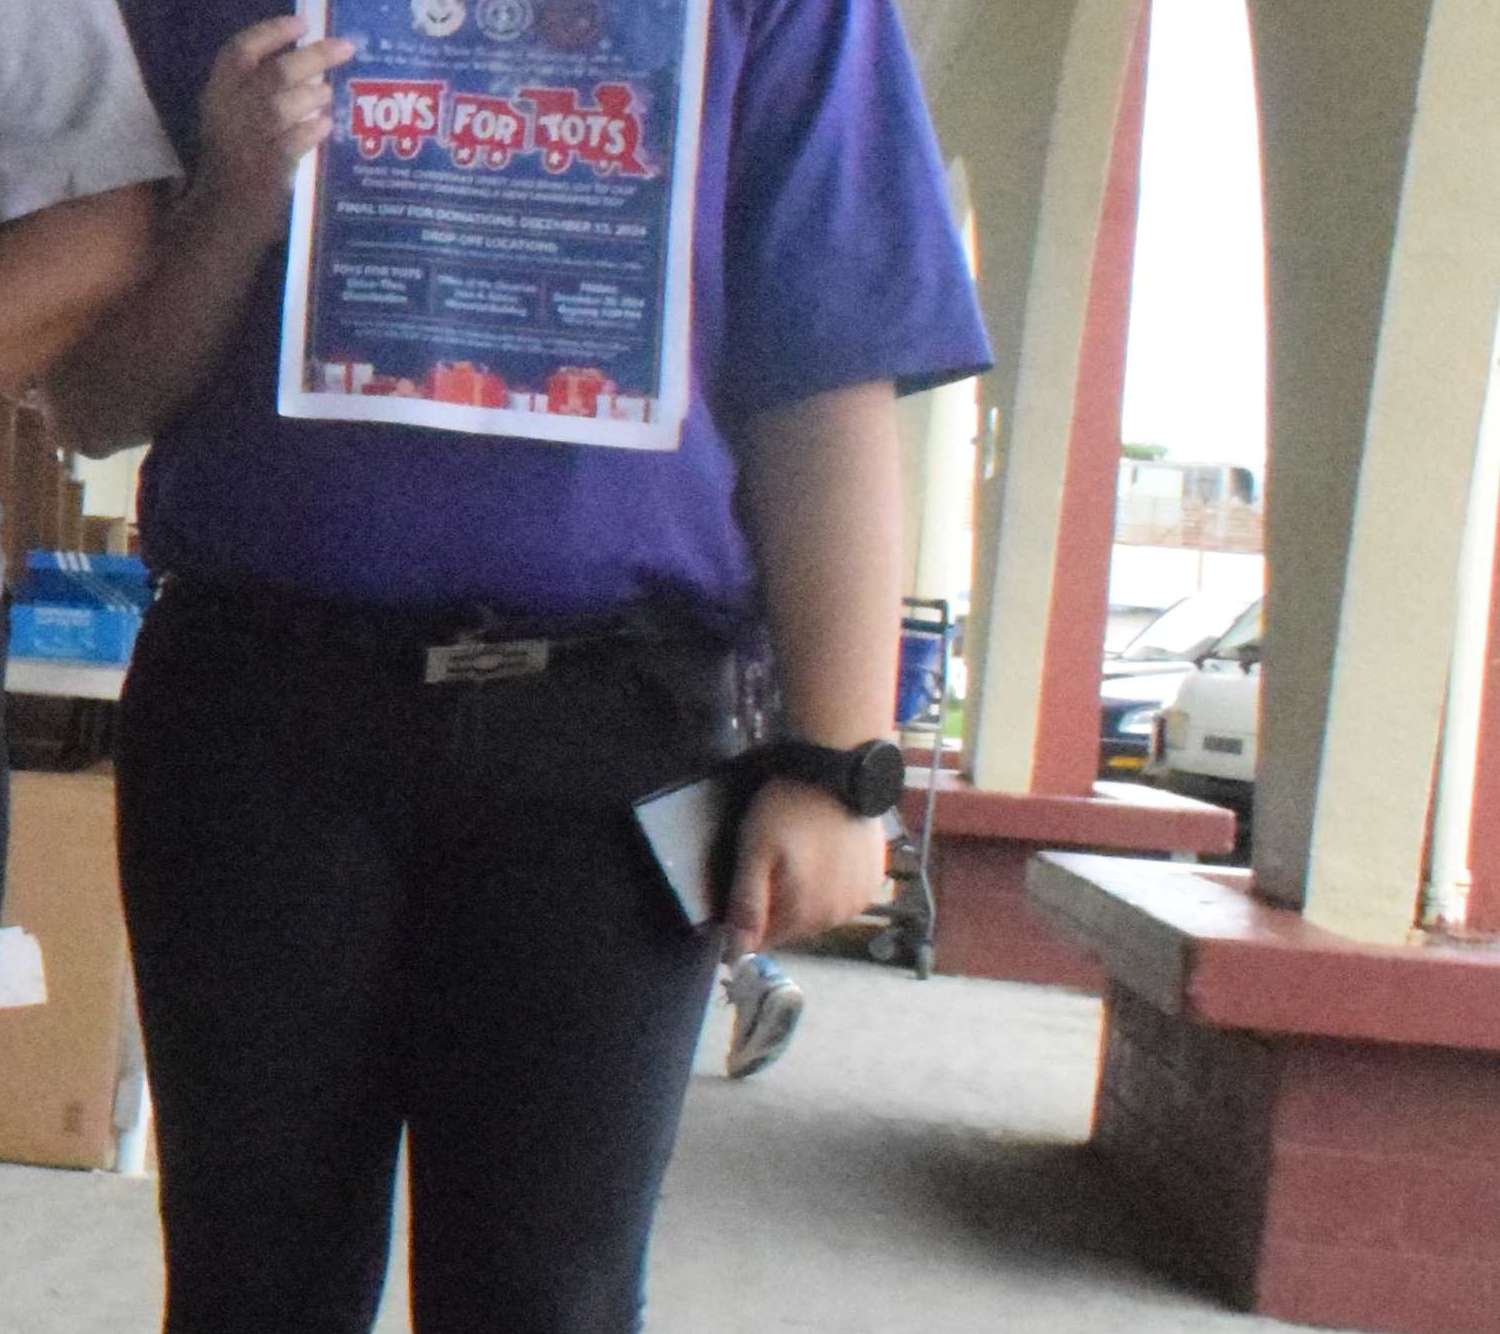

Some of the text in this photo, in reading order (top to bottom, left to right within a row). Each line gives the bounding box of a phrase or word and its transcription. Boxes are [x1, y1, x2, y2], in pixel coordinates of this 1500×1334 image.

[357, 91, 626, 155] TOYS FOR TOTS
